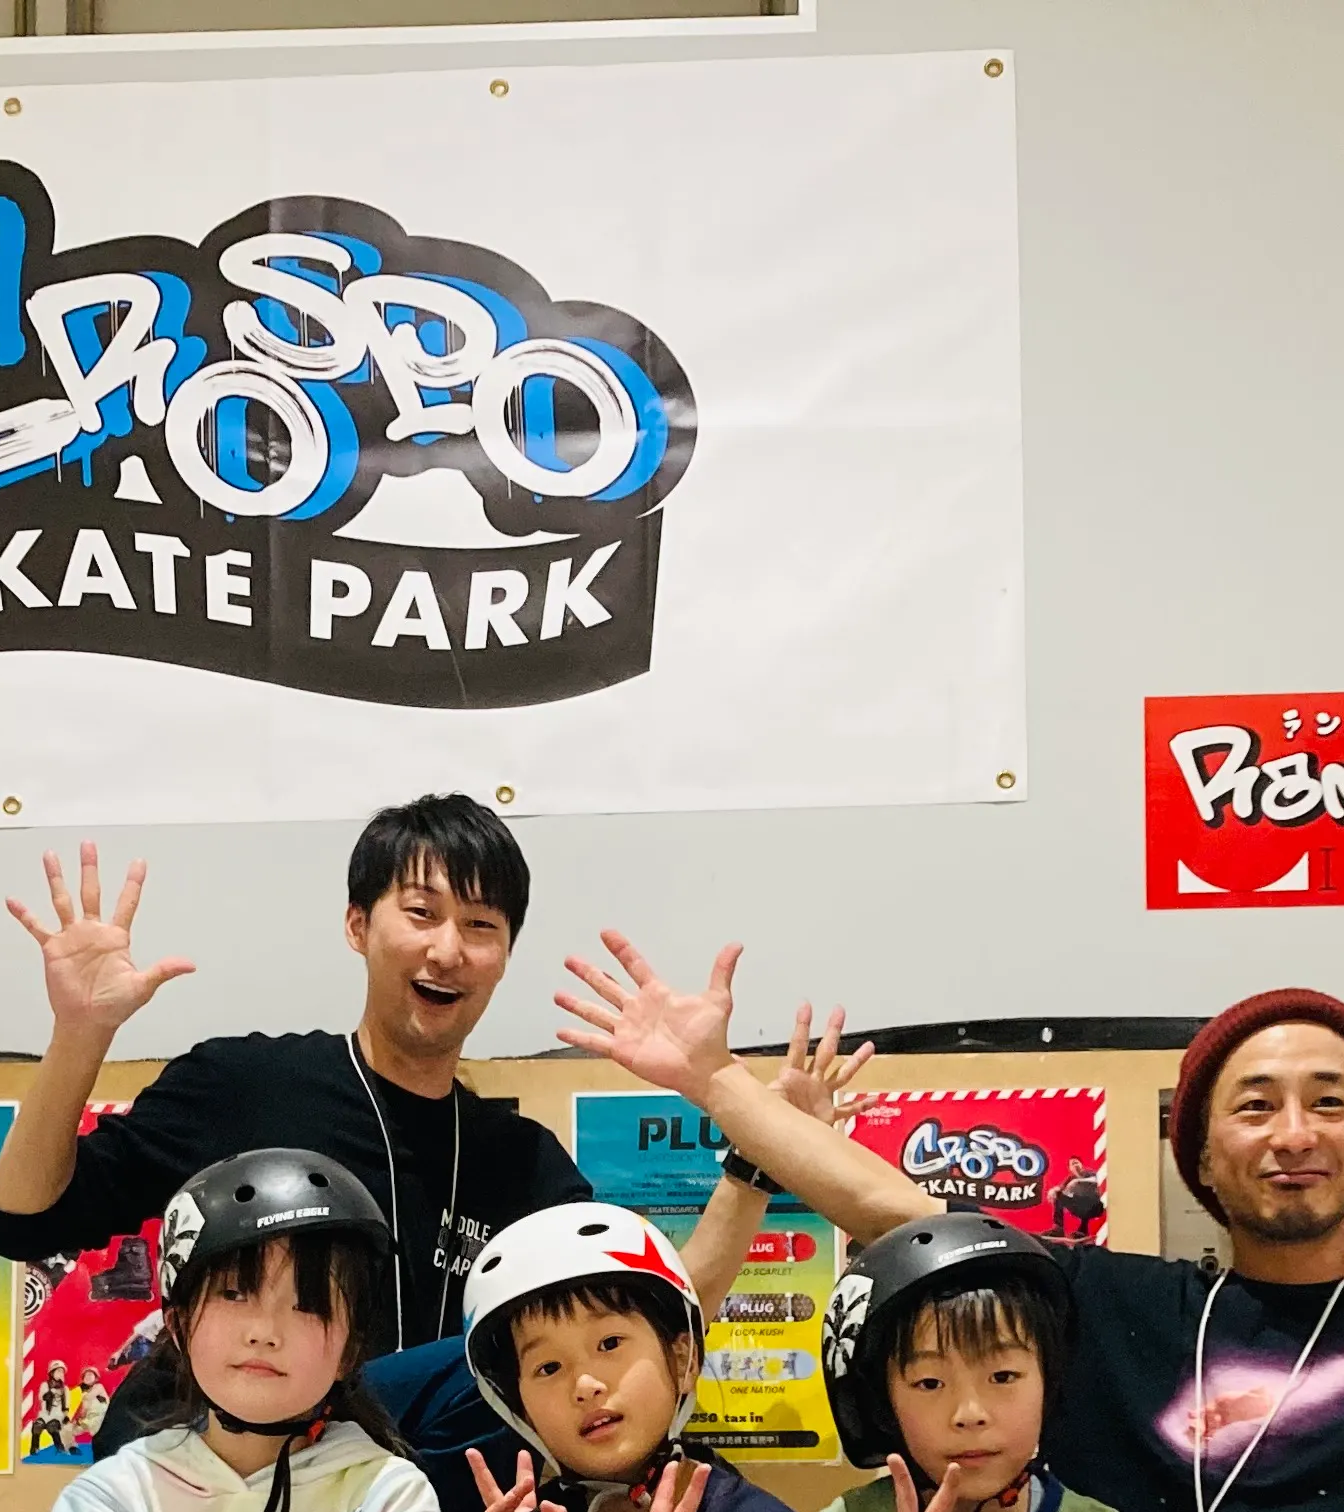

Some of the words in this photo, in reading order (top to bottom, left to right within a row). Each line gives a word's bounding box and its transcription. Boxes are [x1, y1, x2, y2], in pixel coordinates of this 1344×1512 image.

[308, 541, 625, 651] PARK
[638, 1117, 732, 1151] PLU
[920, 1178, 977, 1197] SKATE
[985, 1182, 1038, 1202] PARK
[257, 1210, 295, 1228] FLYING
[296, 1207, 330, 1218] EAGLE
[441, 1208, 491, 1243] MDDLE
[749, 1242, 775, 1253] LUG
[739, 1302, 775, 1314] PLUG
[730, 1386, 748, 1394] ONE
[750, 1385, 786, 1394] NATION
[724, 1413, 747, 1423] tax
[750, 1412, 764, 1423] in
